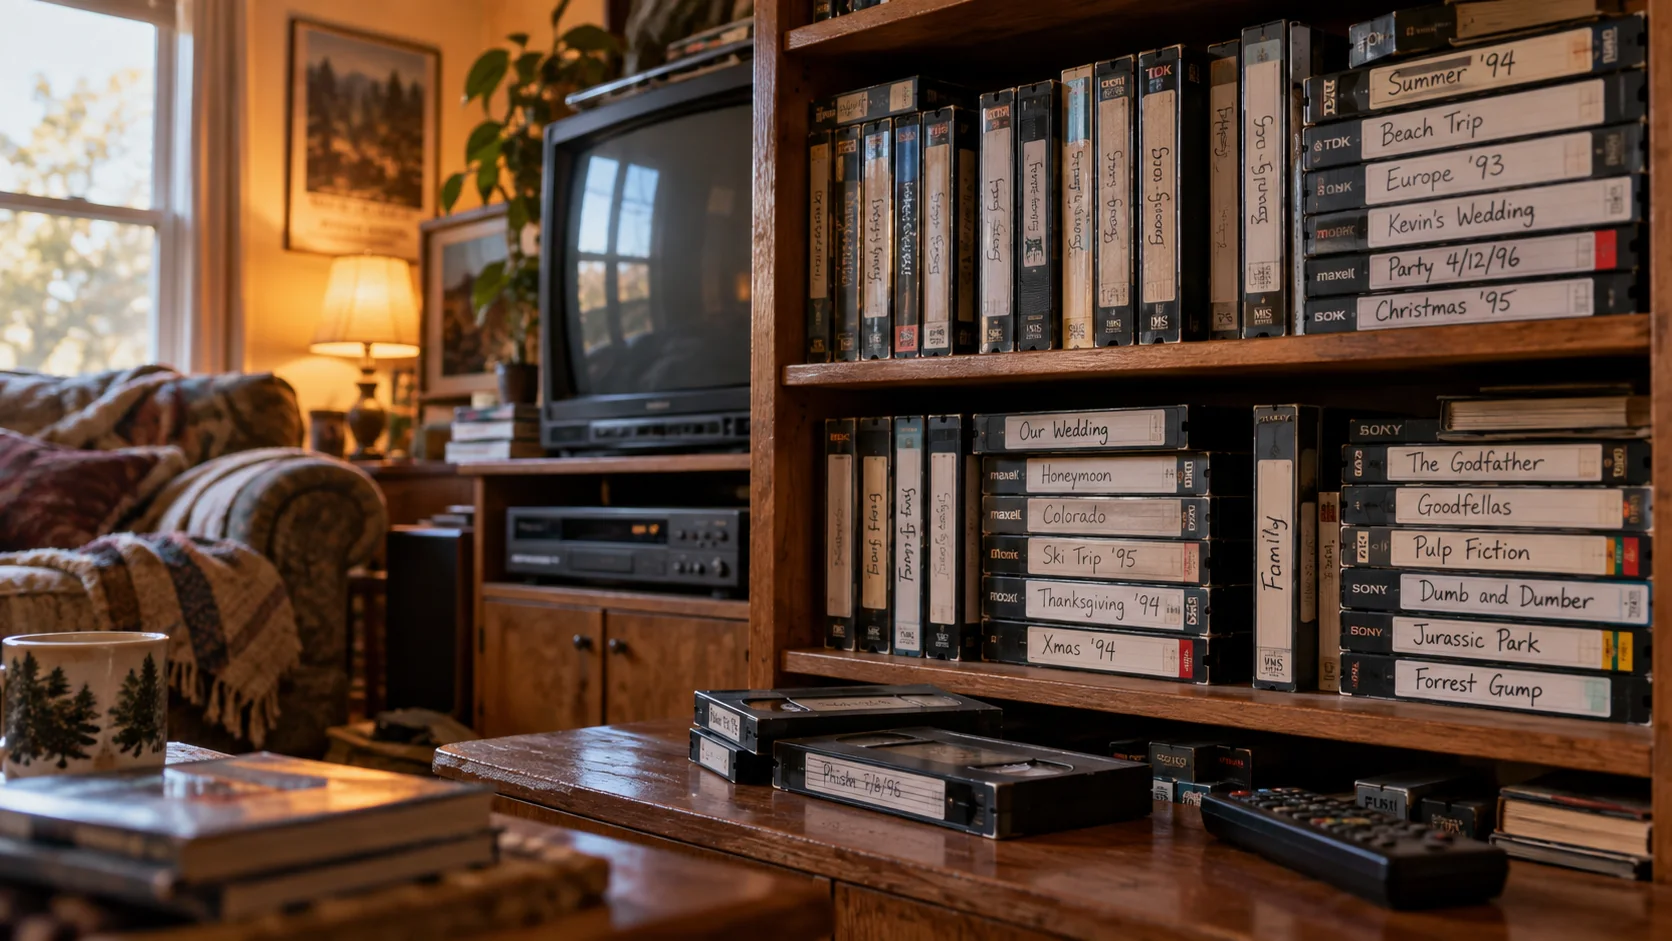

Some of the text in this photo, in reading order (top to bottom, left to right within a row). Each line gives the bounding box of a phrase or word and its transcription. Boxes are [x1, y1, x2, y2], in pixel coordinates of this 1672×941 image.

[1387, 50, 1516, 96] Summer '94
[1323, 135, 1351, 150] TDK
[1380, 111, 1484, 147] Beach Trip
[1386, 154, 1505, 192] Europe '93
[1388, 210, 1445, 237] Kevin's
[1457, 200, 1535, 228] Wedding
[1388, 245, 1520, 283] Party 4/12/96
[1376, 289, 1518, 322] Christmas '95
[1019, 419, 1109, 446] Our Wedding
[1359, 424, 1403, 436] SONY
[1041, 463, 1112, 490] Honeymoon
[1406, 451, 1545, 474] The Godfather
[1043, 504, 1106, 525] Colorado
[1417, 493, 1512, 516] Goodfellas
[1042, 544, 1065, 566] Ski
[1073, 546, 1102, 574] Trip
[1111, 547, 1138, 568] '95
[1260, 516, 1288, 591] Family
[1413, 535, 1530, 565] Pulp Fiction
[1037, 587, 1125, 621] Thanksgiving
[1135, 593, 1160, 618] '94
[1351, 583, 1388, 595] SONY
[1419, 579, 1595, 610] Dumb and Dumber
[1350, 625, 1384, 637] SONY
[1413, 623, 1541, 653] Jurassic Park
[1042, 633, 1116, 662] Xmas '94
[1415, 668, 1543, 707] Forrest Gump
